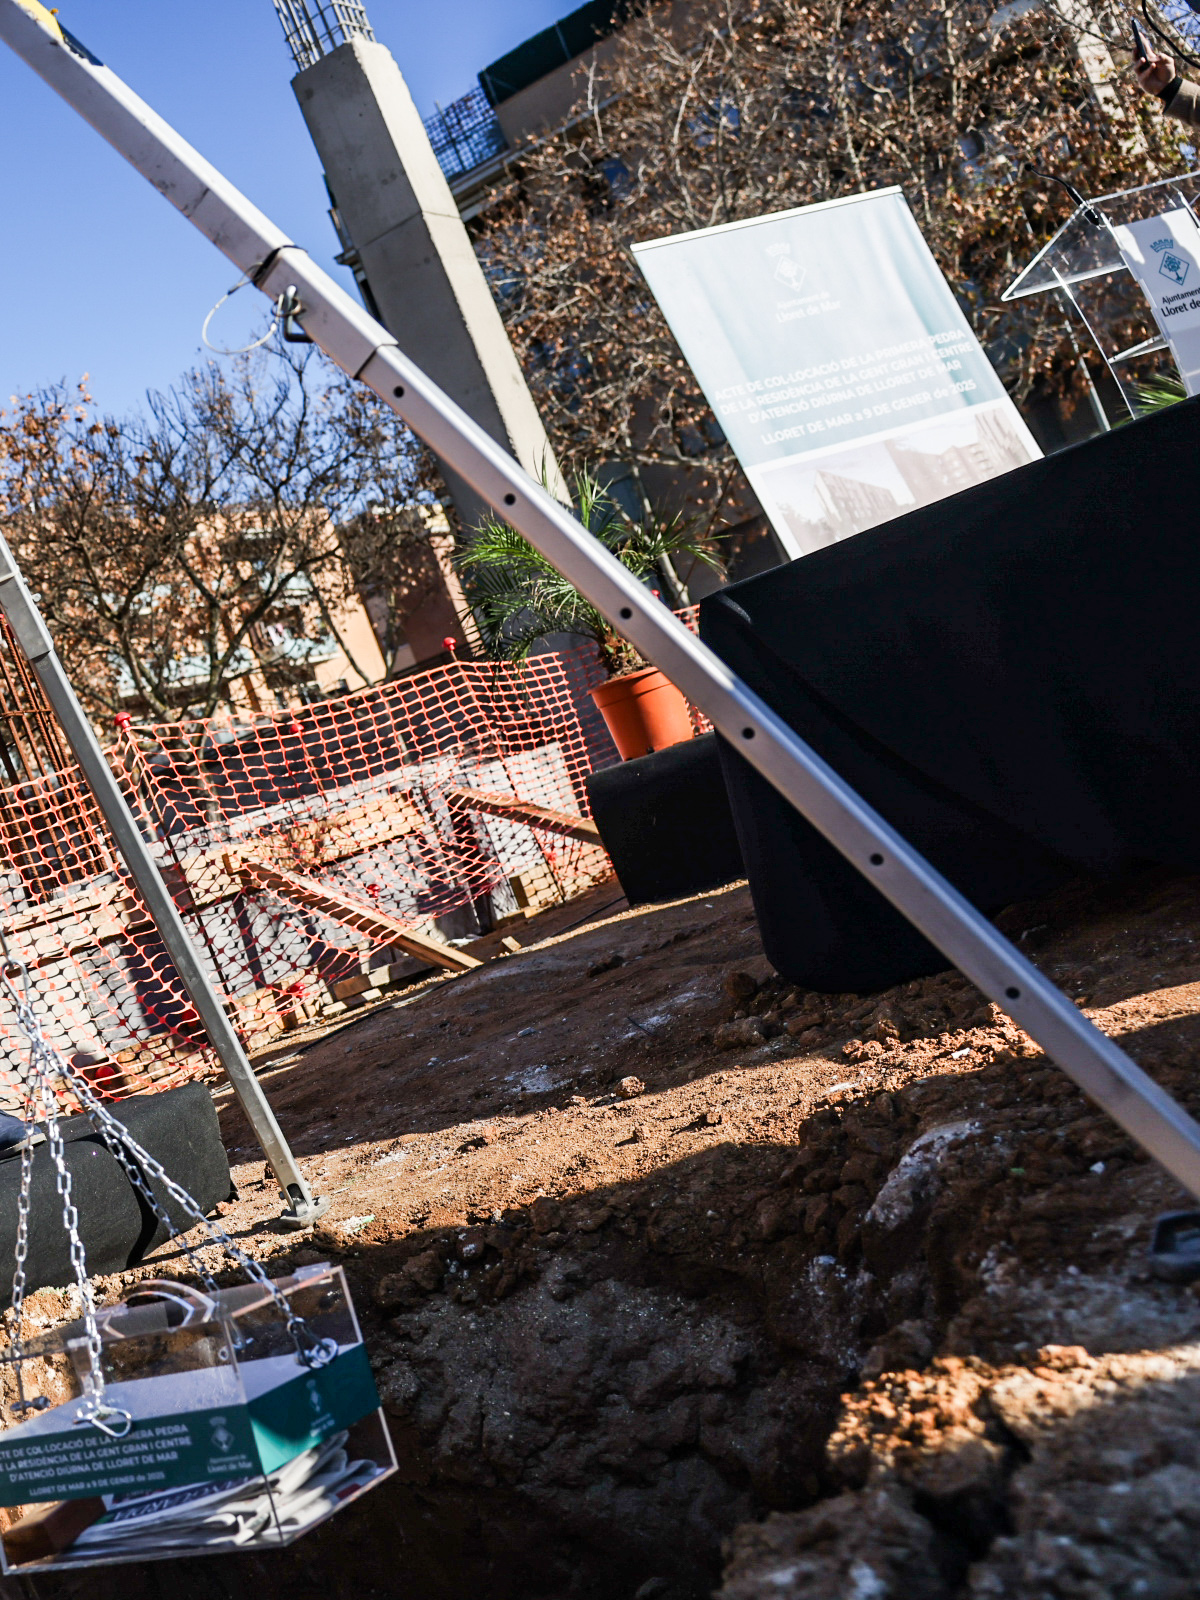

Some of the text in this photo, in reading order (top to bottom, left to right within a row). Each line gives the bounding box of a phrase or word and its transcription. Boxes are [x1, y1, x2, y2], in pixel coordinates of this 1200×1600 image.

[776, 300, 841, 323] Lloret de Mar
[1161, 299, 1200, 317] Lloret de
[714, 384, 746, 401] ACTE
[746, 380, 764, 393] DE
[841, 356, 859, 370] DE
[858, 352, 876, 365] LA
[874, 339, 928, 361] PRIMERA
[928, 329, 966, 345] PEDRA
[720, 403, 739, 416] DE
[739, 398, 757, 411] LA
[824, 376, 843, 390] DE
[842, 371, 860, 385] LA
[859, 363, 890, 380] GENT
[890, 353, 922, 371] GRAN
[930, 341, 974, 360] CENTRE
[855, 383, 875, 398] DE
[873, 371, 919, 393] LLORET
[917, 366, 937, 380] DE
[935, 358, 963, 374] MAR
[760, 425, 806, 445] LLORET
[806, 420, 826, 434] DE
[825, 412, 854, 429] MAR
[862, 408, 873, 419] 9
[871, 402, 893, 417] DE
[891, 390, 934, 411] GENER
[933, 387, 950, 400] de
[949, 378, 978, 396] 2025
[4, 1460, 17, 1471] LA
[69, 1451, 83, 1462] DE
[83, 1449, 96, 1460] LA
[96, 1446, 121, 1458] GENT
[121, 1441, 149, 1454] GRAN
[155, 1435, 193, 1449] CENTRE
[12, 1447, 25, 1458] DE
[85, 1436, 99, 1448] DE
[99, 1434, 112, 1445] LA
[155, 1423, 189, 1437] PEDRA
[91, 1461, 105, 1472] DE
[105, 1454, 142, 1469] LLORET
[141, 1453, 156, 1465] DE
[155, 1450, 179, 1461] MAR
[28, 1485, 57, 1497] LLORET
[56, 1483, 68, 1493] DE
[67, 1480, 86, 1490] MAR
[97, 1477, 110, 1487] DE
[135, 1474, 146, 1482] de
